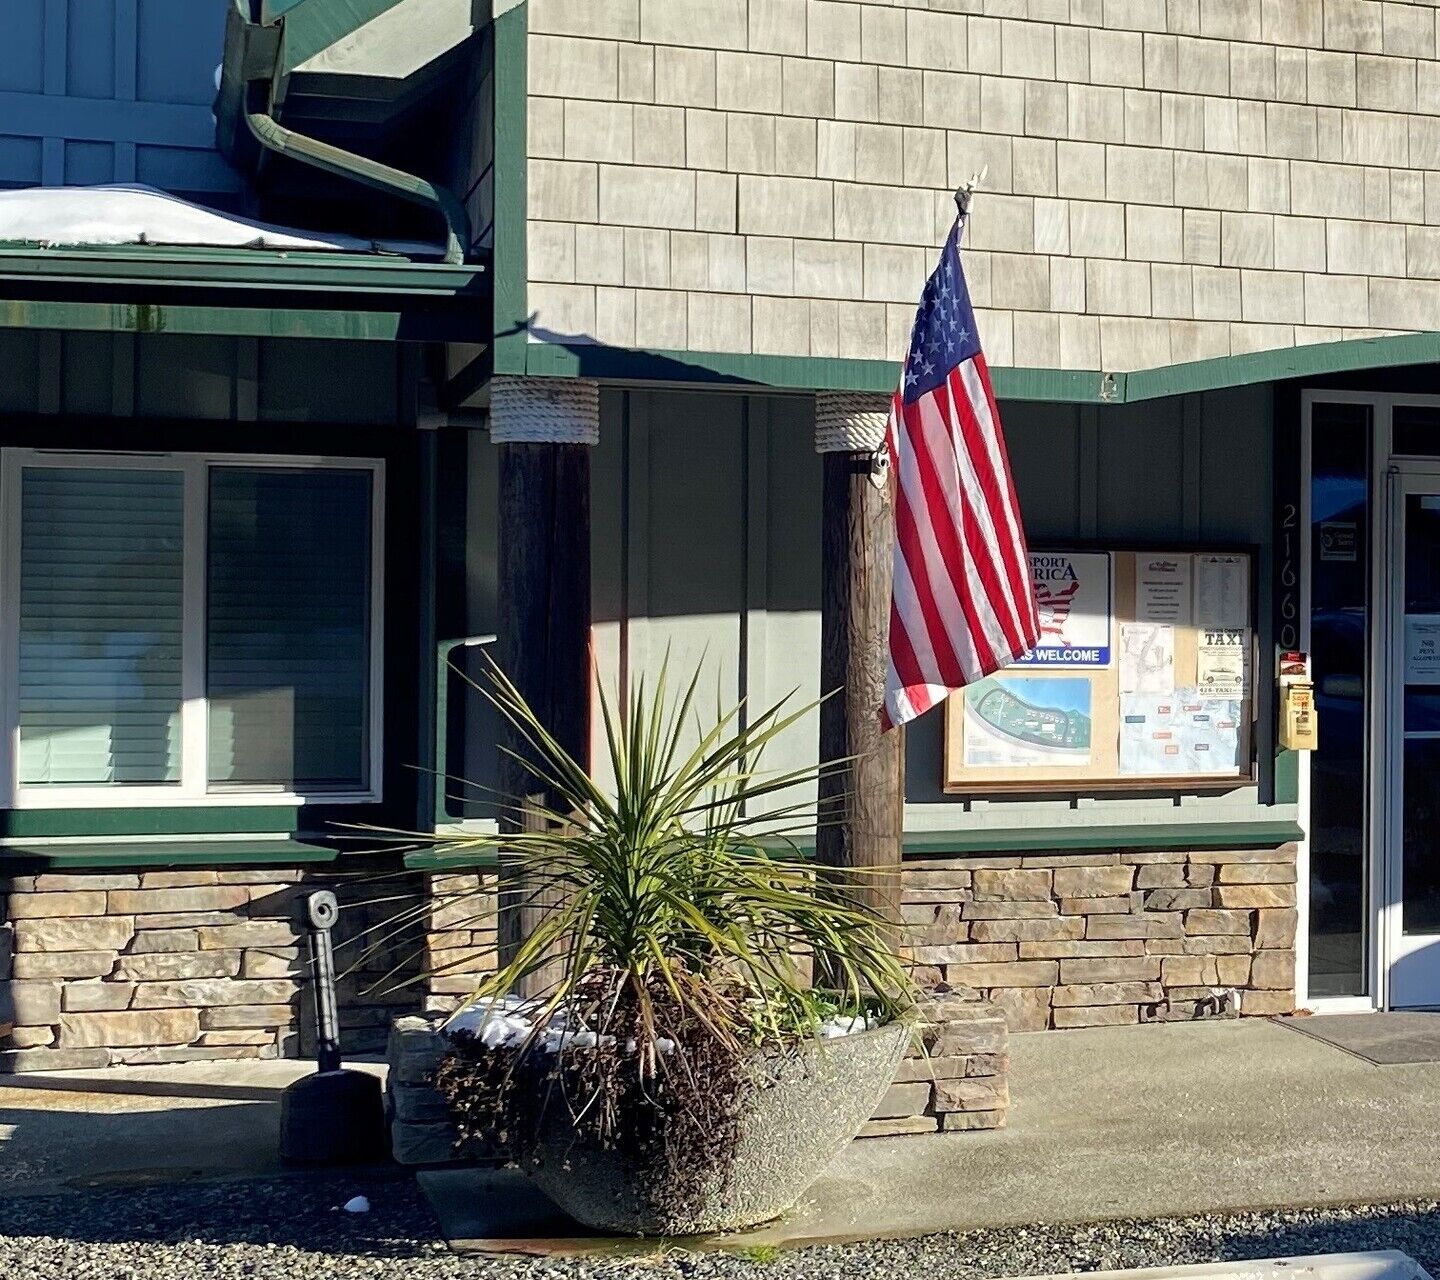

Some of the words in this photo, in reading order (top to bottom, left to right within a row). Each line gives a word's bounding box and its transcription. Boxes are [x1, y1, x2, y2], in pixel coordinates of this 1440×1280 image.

[1033, 562, 1079, 581] RICA
[1204, 634, 1244, 646] TAXI
[1036, 649, 1101, 663] WELCOME
